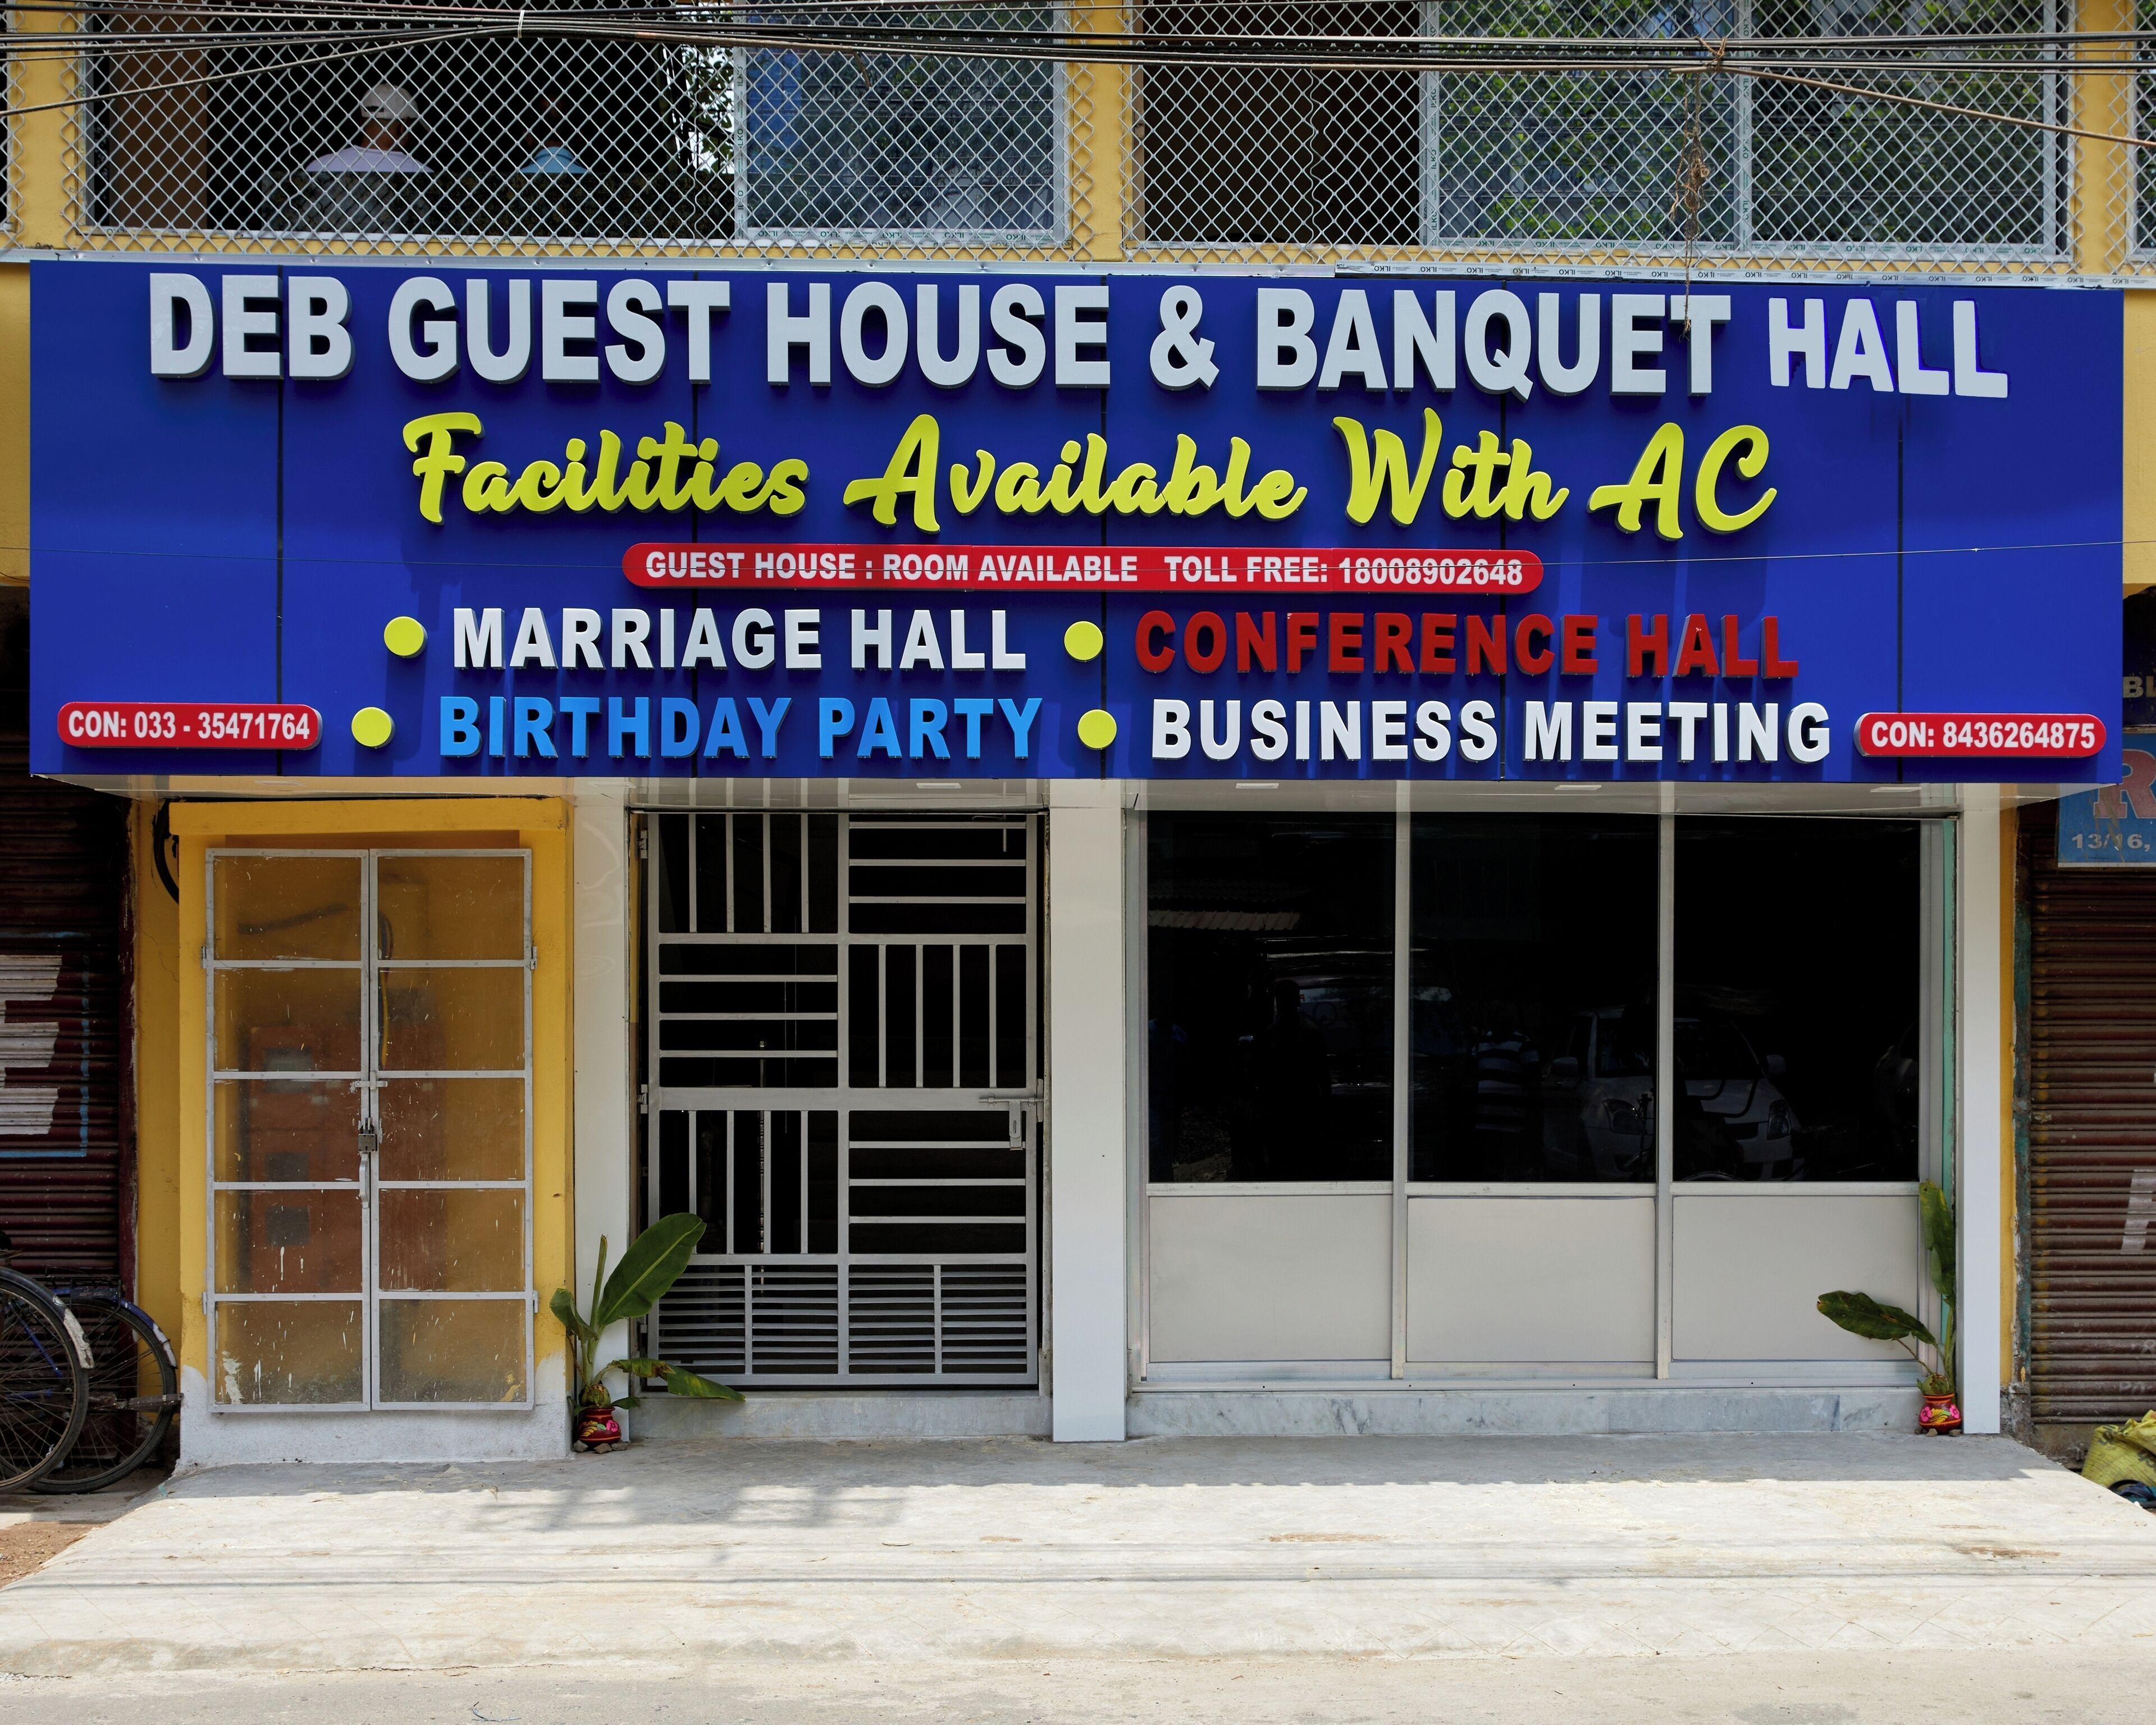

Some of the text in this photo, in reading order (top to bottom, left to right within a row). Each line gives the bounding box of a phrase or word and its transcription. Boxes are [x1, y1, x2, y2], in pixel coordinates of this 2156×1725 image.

[150, 273, 2009, 403] DEB GUEST HOUSE & BANQUET HALL
[403, 407, 1778, 541] Facilities Available With AC
[646, 551, 746, 579] GUEST
[755, 553, 856, 580] HOUSE
[883, 554, 969, 581] ROOM
[977, 555, 1138, 582] AVAILABLE
[1164, 556, 1237, 583] TOLL
[1247, 557, 1327, 583] FREE:
[1339, 558, 1523, 585] 18008902648
[453, 608, 1026, 671] MARRIAGE HALL
[1135, 610, 1798, 679] CONFERENCE HALL
[68, 710, 126, 737] CON:
[134, 711, 175, 738] 033
[198, 711, 310, 740] 35471764
[440, 696, 1043, 759] BIRTHDAY PARTY
[1152, 699, 1830, 763] BUSINESS MEETING
[1871, 722, 2095, 749] CON: 8436264875
